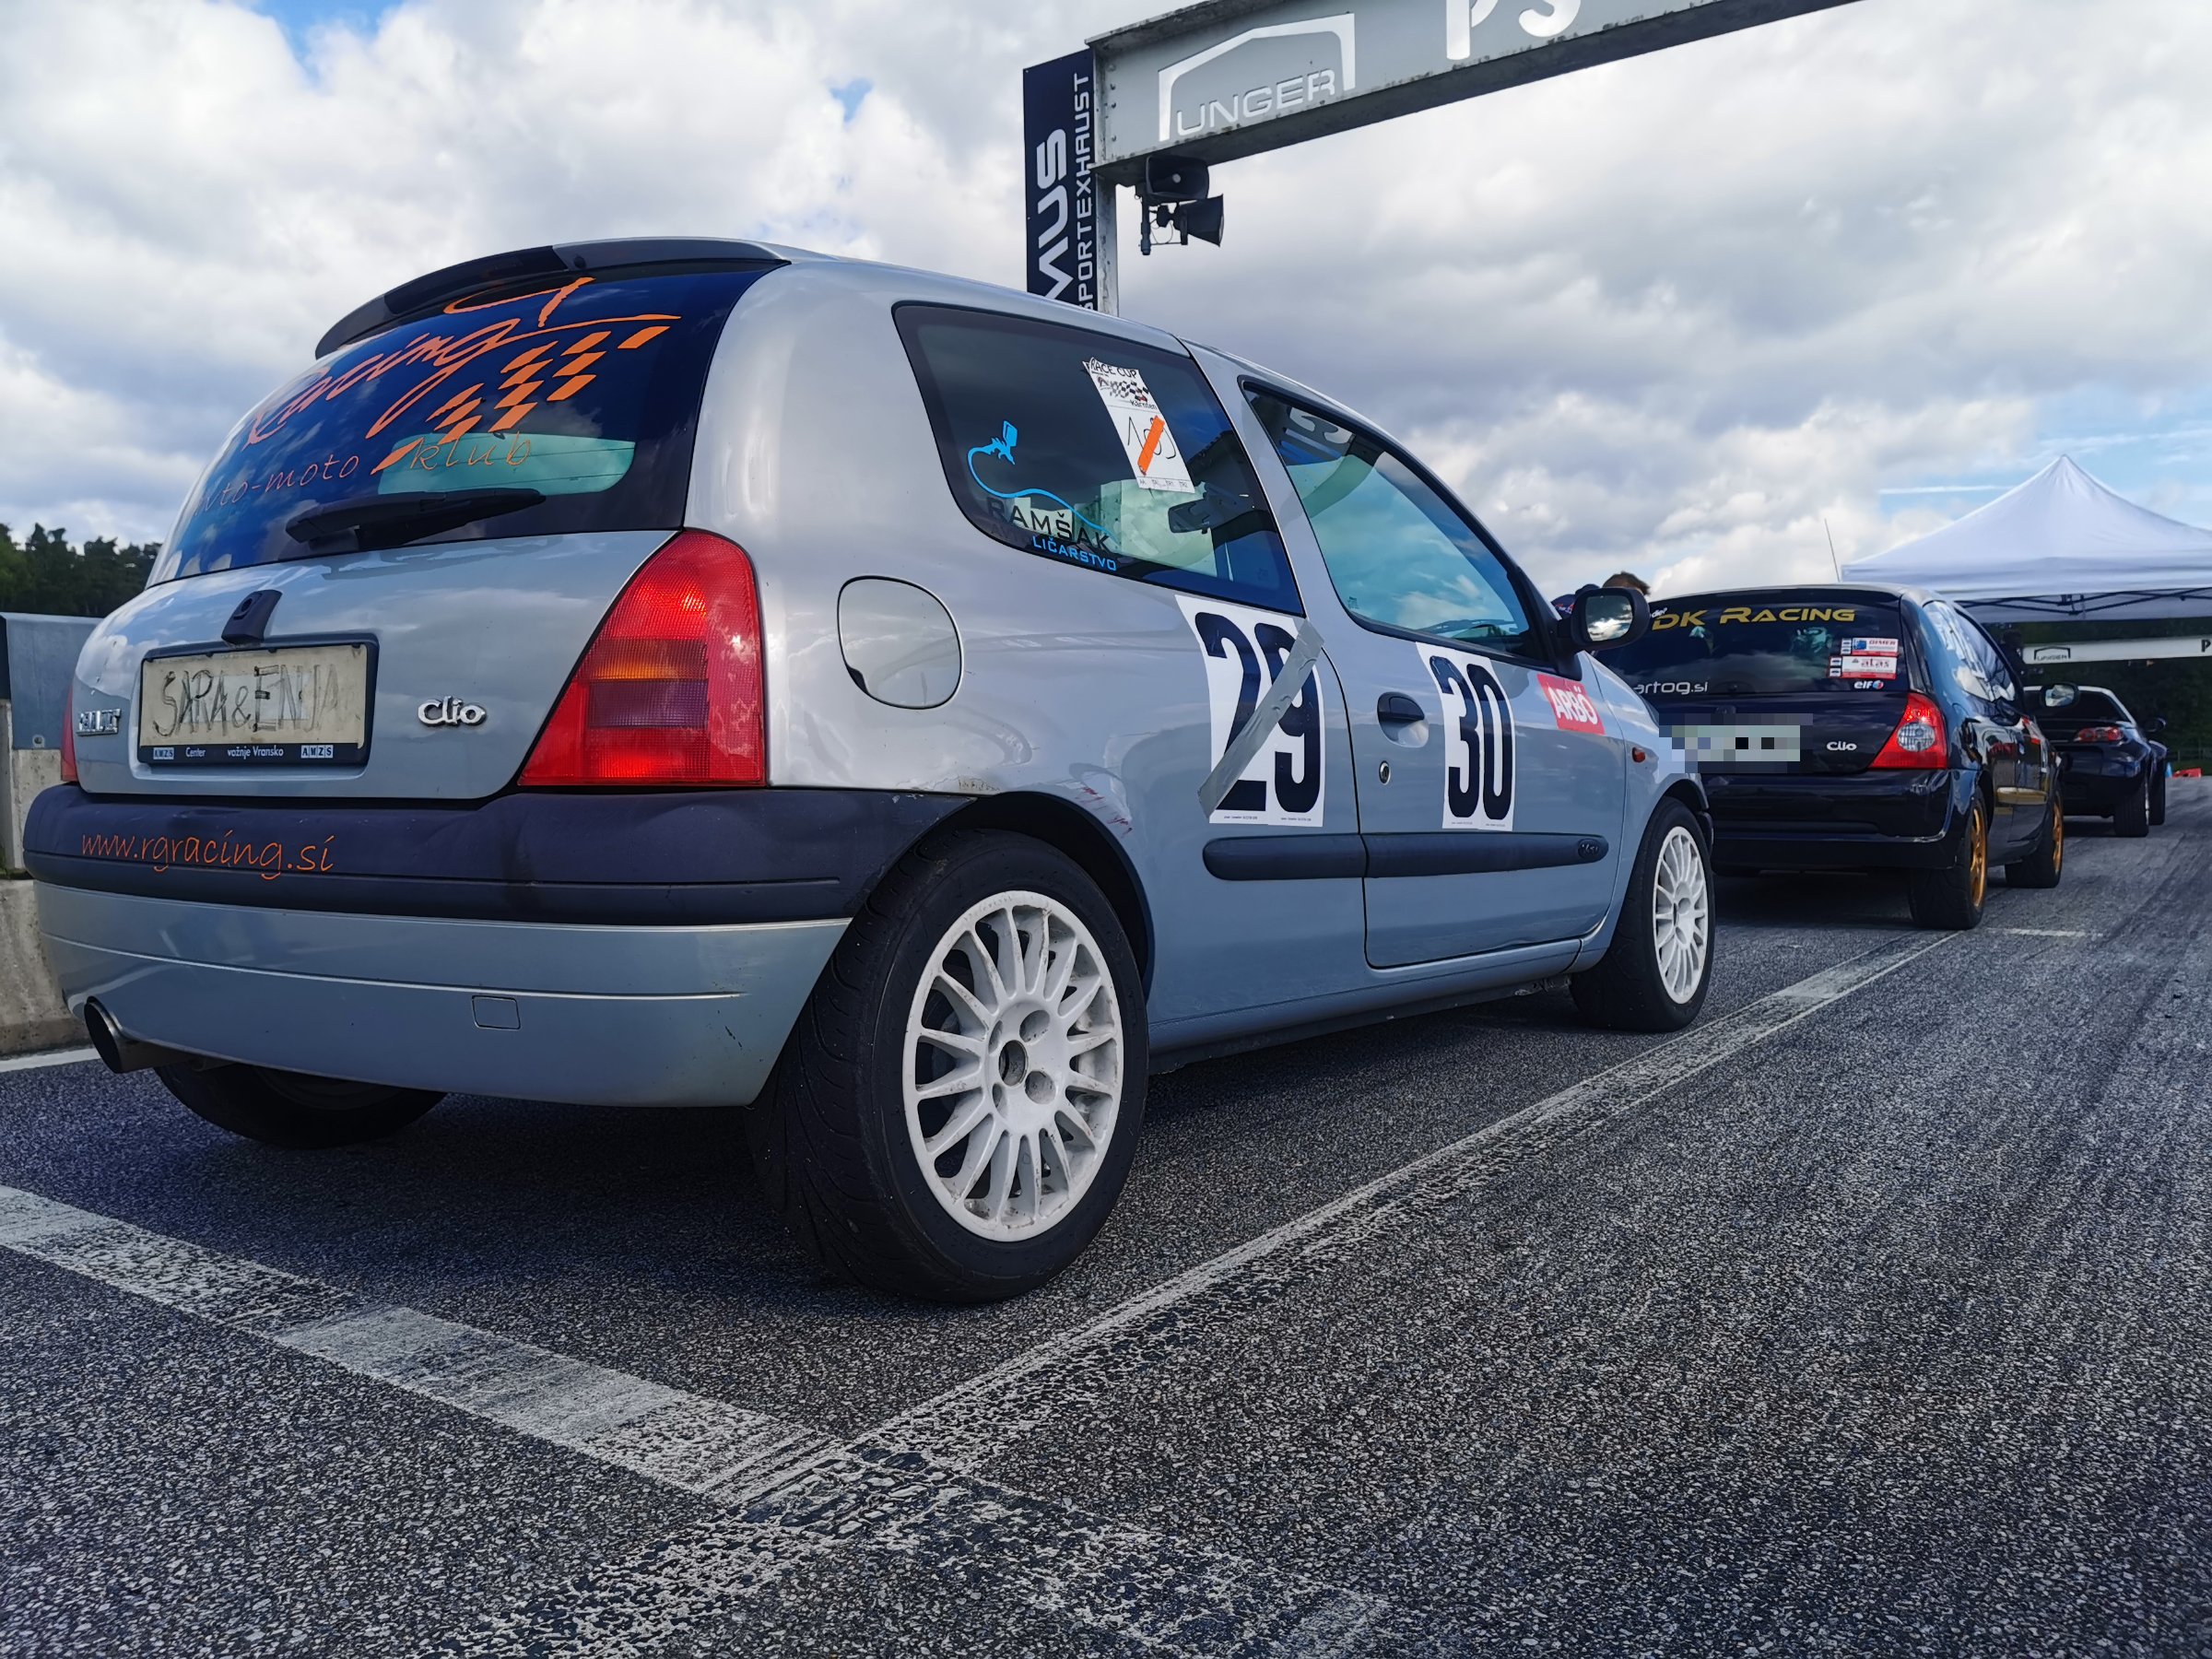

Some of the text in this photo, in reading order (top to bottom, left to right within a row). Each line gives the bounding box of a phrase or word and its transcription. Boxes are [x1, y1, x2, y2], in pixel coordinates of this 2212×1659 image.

[1177, 67, 1335, 136] UNGER
[1036, 128, 1074, 300] MUS
[1090, 359, 1116, 375] RACE
[1117, 368, 1137, 379] CUP
[194, 430, 532, 516] vto-moto klub
[986, 495, 1112, 554] RAMŠAK
[1032, 535, 1117, 571] LIČARSTVO
[1652, 609, 1708, 630] DK
[1854, 680, 1874, 689] elf
[418, 695, 488, 728] Clio
[1194, 611, 1321, 814] 29
[1548, 685, 1598, 725] ARBÖ
[185, 747, 206, 758] Center
[227, 746, 252, 760] vožnje
[253, 744, 284, 757] Vransko
[300, 744, 335, 759] AMZS
[1429, 654, 1512, 821] 30
[1826, 740, 1857, 752] Clio
[82, 830, 335, 881] www.rgracing.si
